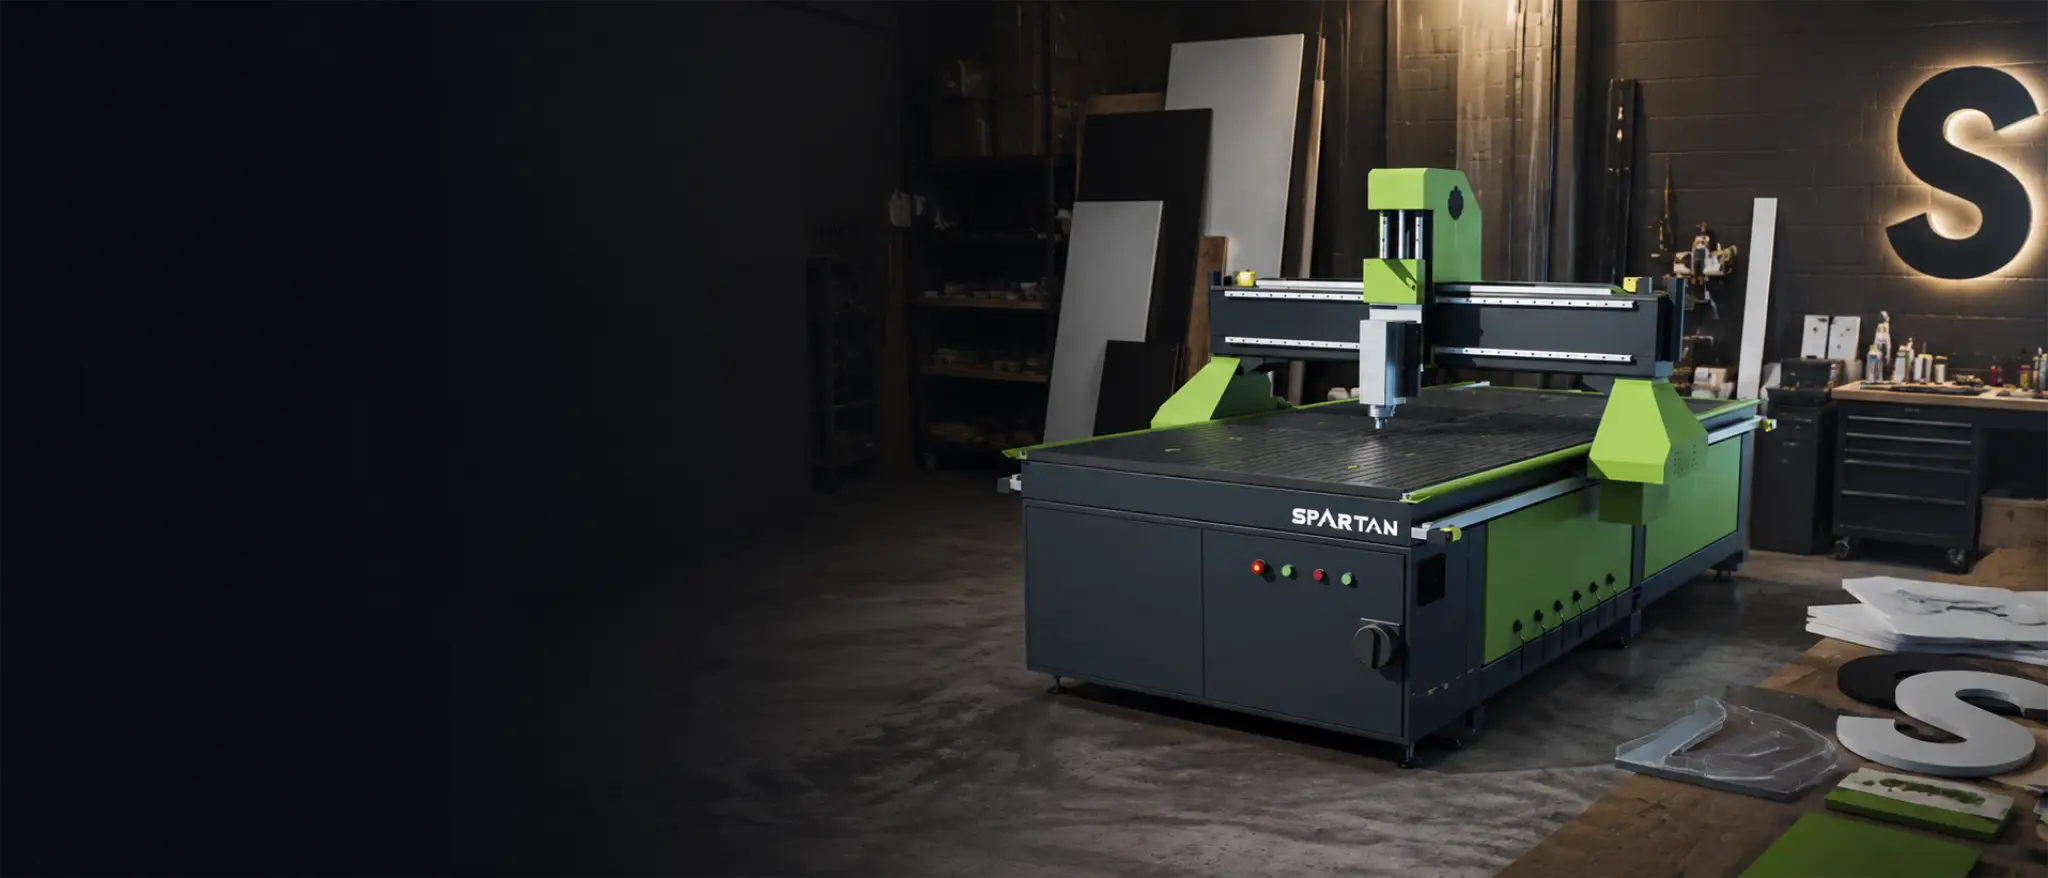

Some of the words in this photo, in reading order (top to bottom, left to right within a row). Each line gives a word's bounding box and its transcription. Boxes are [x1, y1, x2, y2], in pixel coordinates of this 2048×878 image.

[1886, 66, 2039, 279] S
[1292, 508, 1398, 536] SPARTAN
[1836, 669, 2048, 777] S
